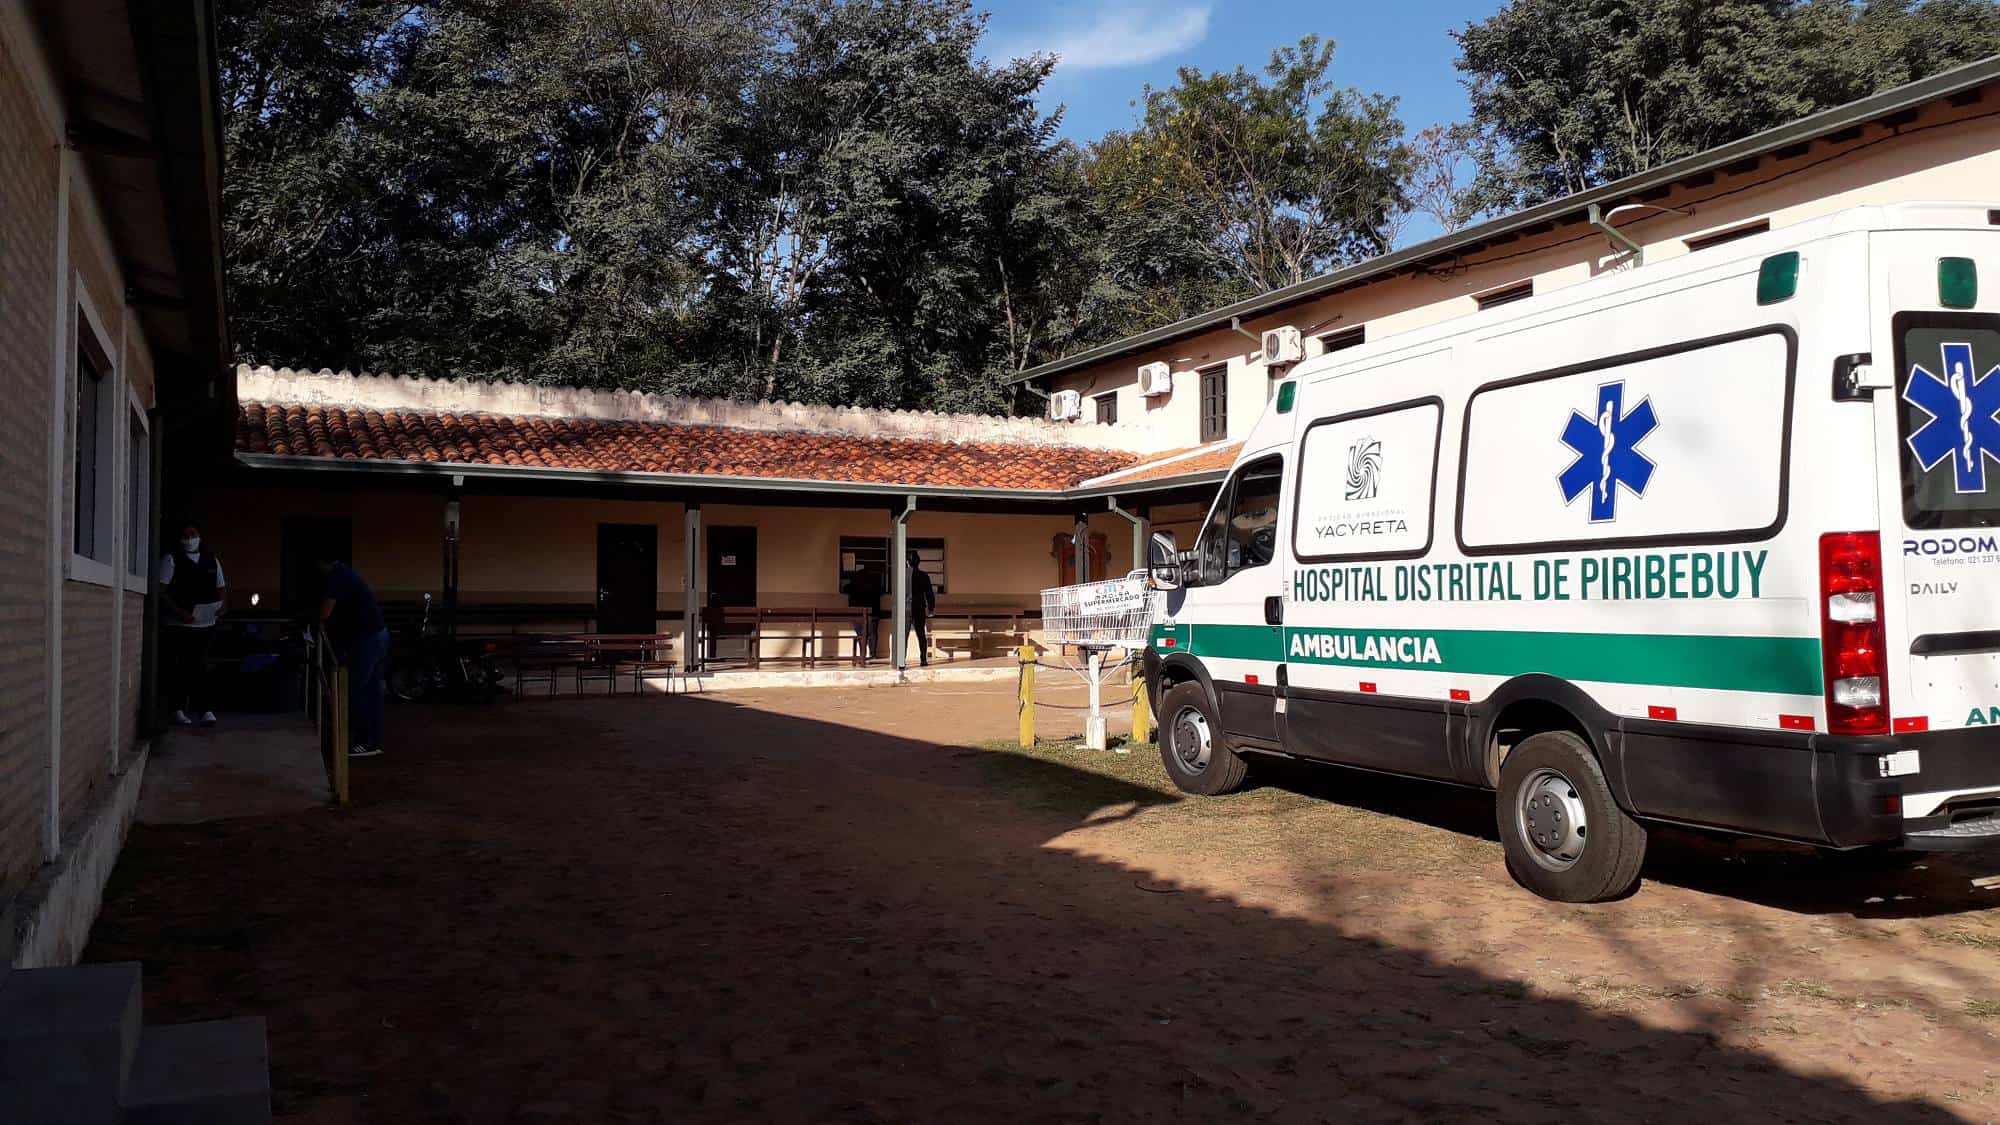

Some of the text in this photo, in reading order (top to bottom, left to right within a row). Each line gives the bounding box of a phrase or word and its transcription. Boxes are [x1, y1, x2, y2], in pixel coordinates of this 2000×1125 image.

[1314, 519, 1409, 539] YACYRETA
[1293, 567, 1388, 602] HOSPITAL
[1395, 561, 1522, 601] DISTRITAL
[1533, 558, 1570, 601] DE
[1581, 549, 1768, 600] PIRIBEBUY
[1910, 581, 1958, 595] DAILY
[1083, 594, 1140, 607] SUPERMERCADO
[1290, 634, 1442, 664] AMBULANCIA
